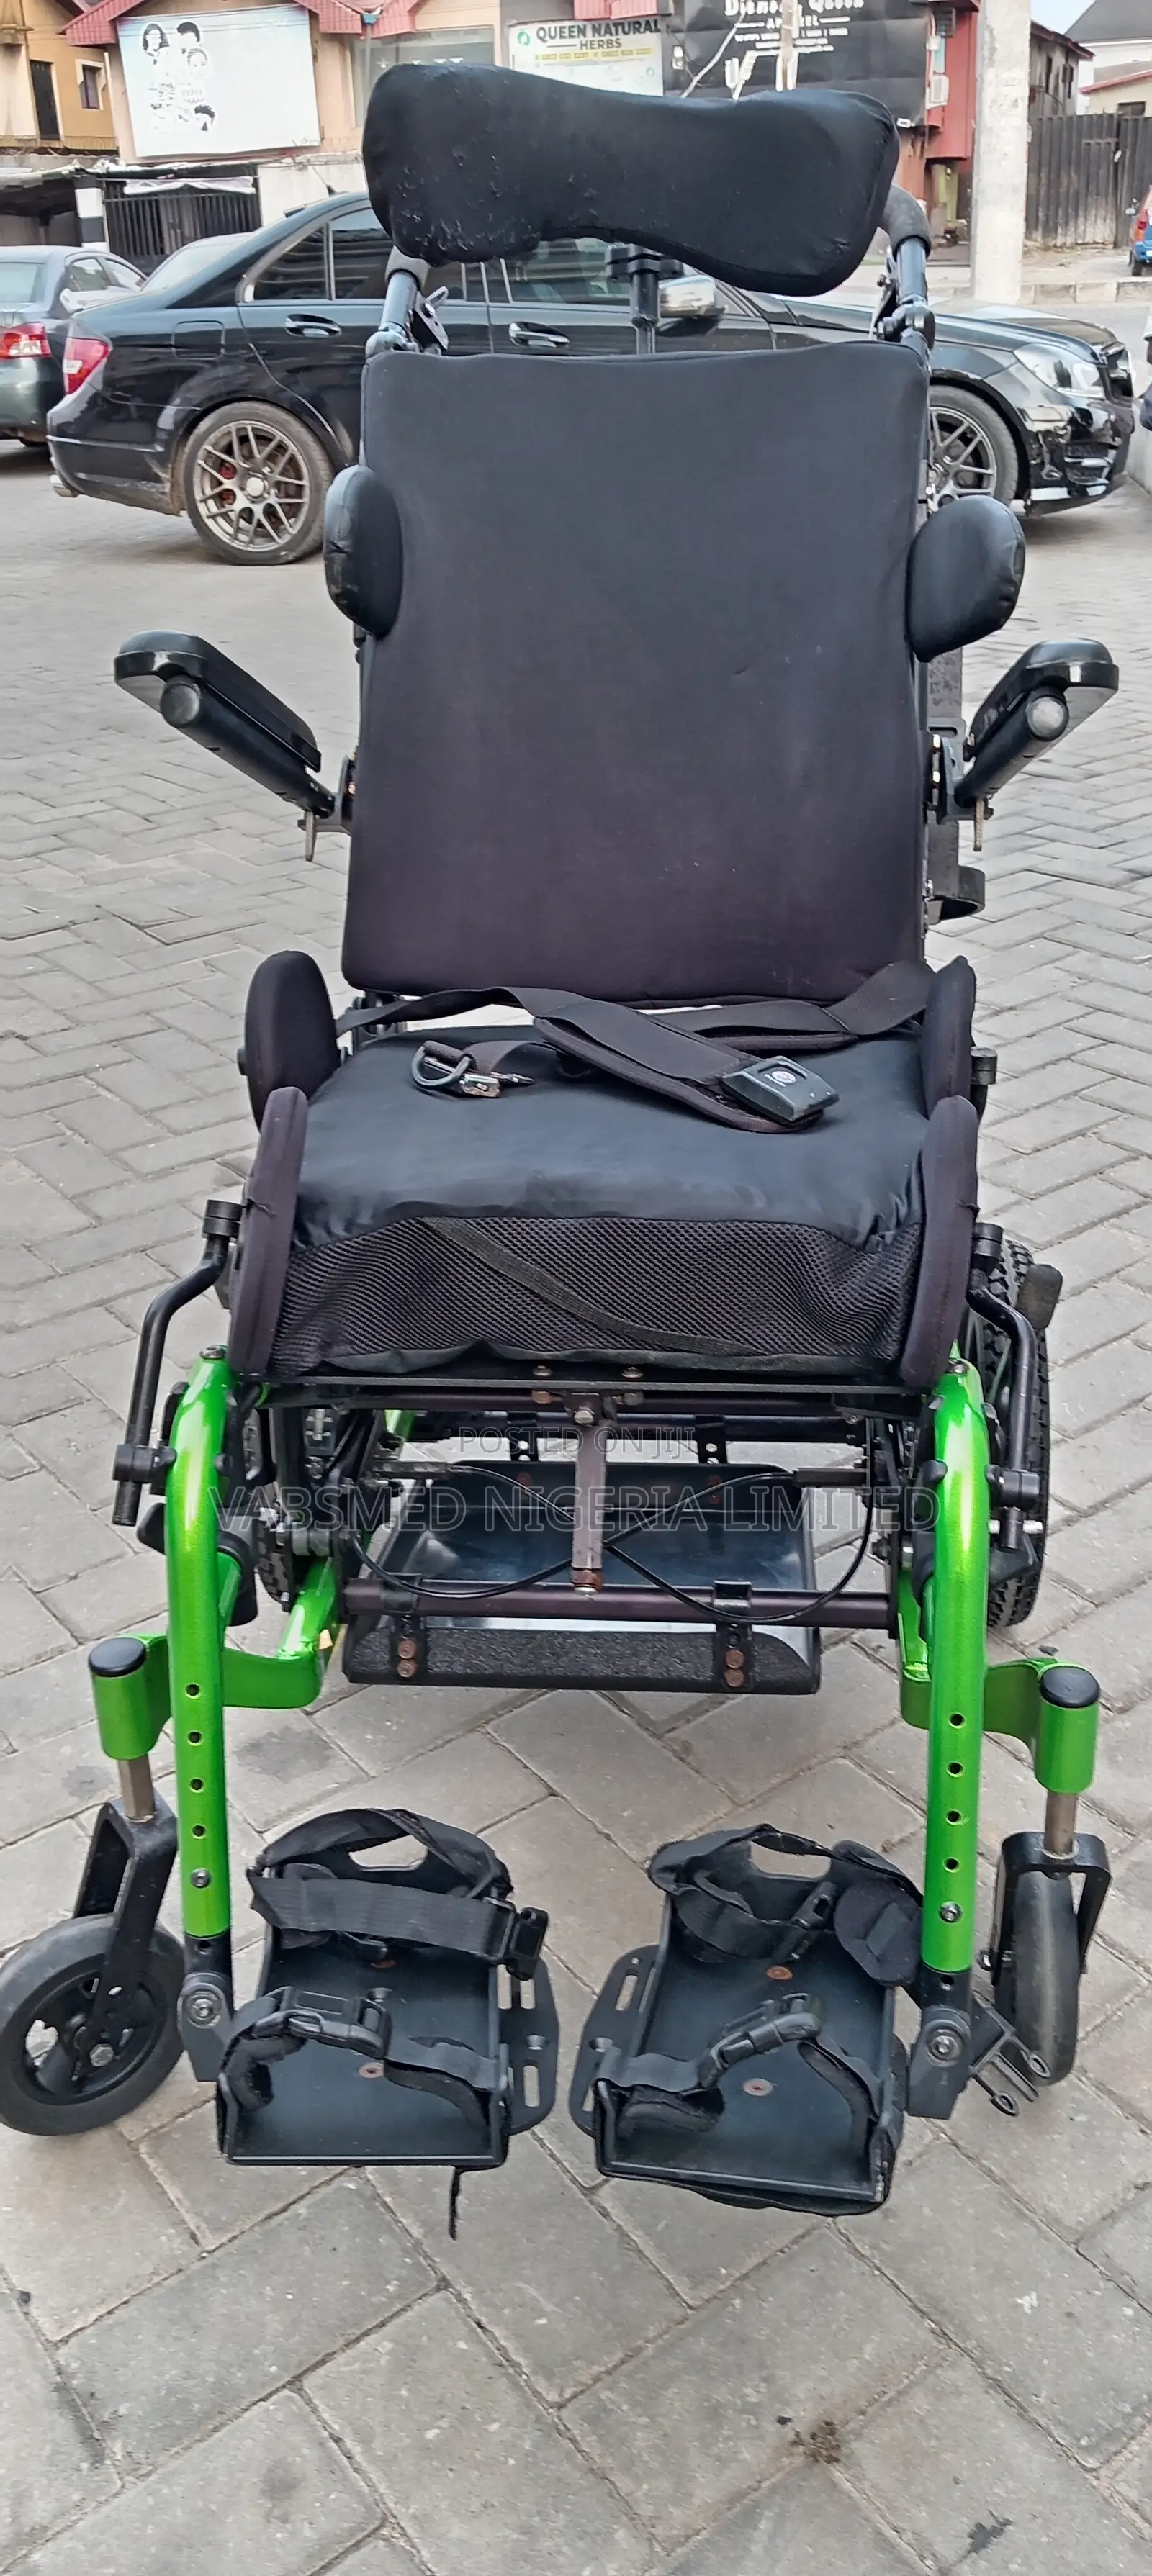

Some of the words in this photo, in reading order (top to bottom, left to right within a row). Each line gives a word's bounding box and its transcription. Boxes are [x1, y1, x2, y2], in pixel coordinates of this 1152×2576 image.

[536, 24, 588, 43] QUEEN
[591, 19, 661, 38] NATURAL
[580, 38, 622, 50] HERBS
